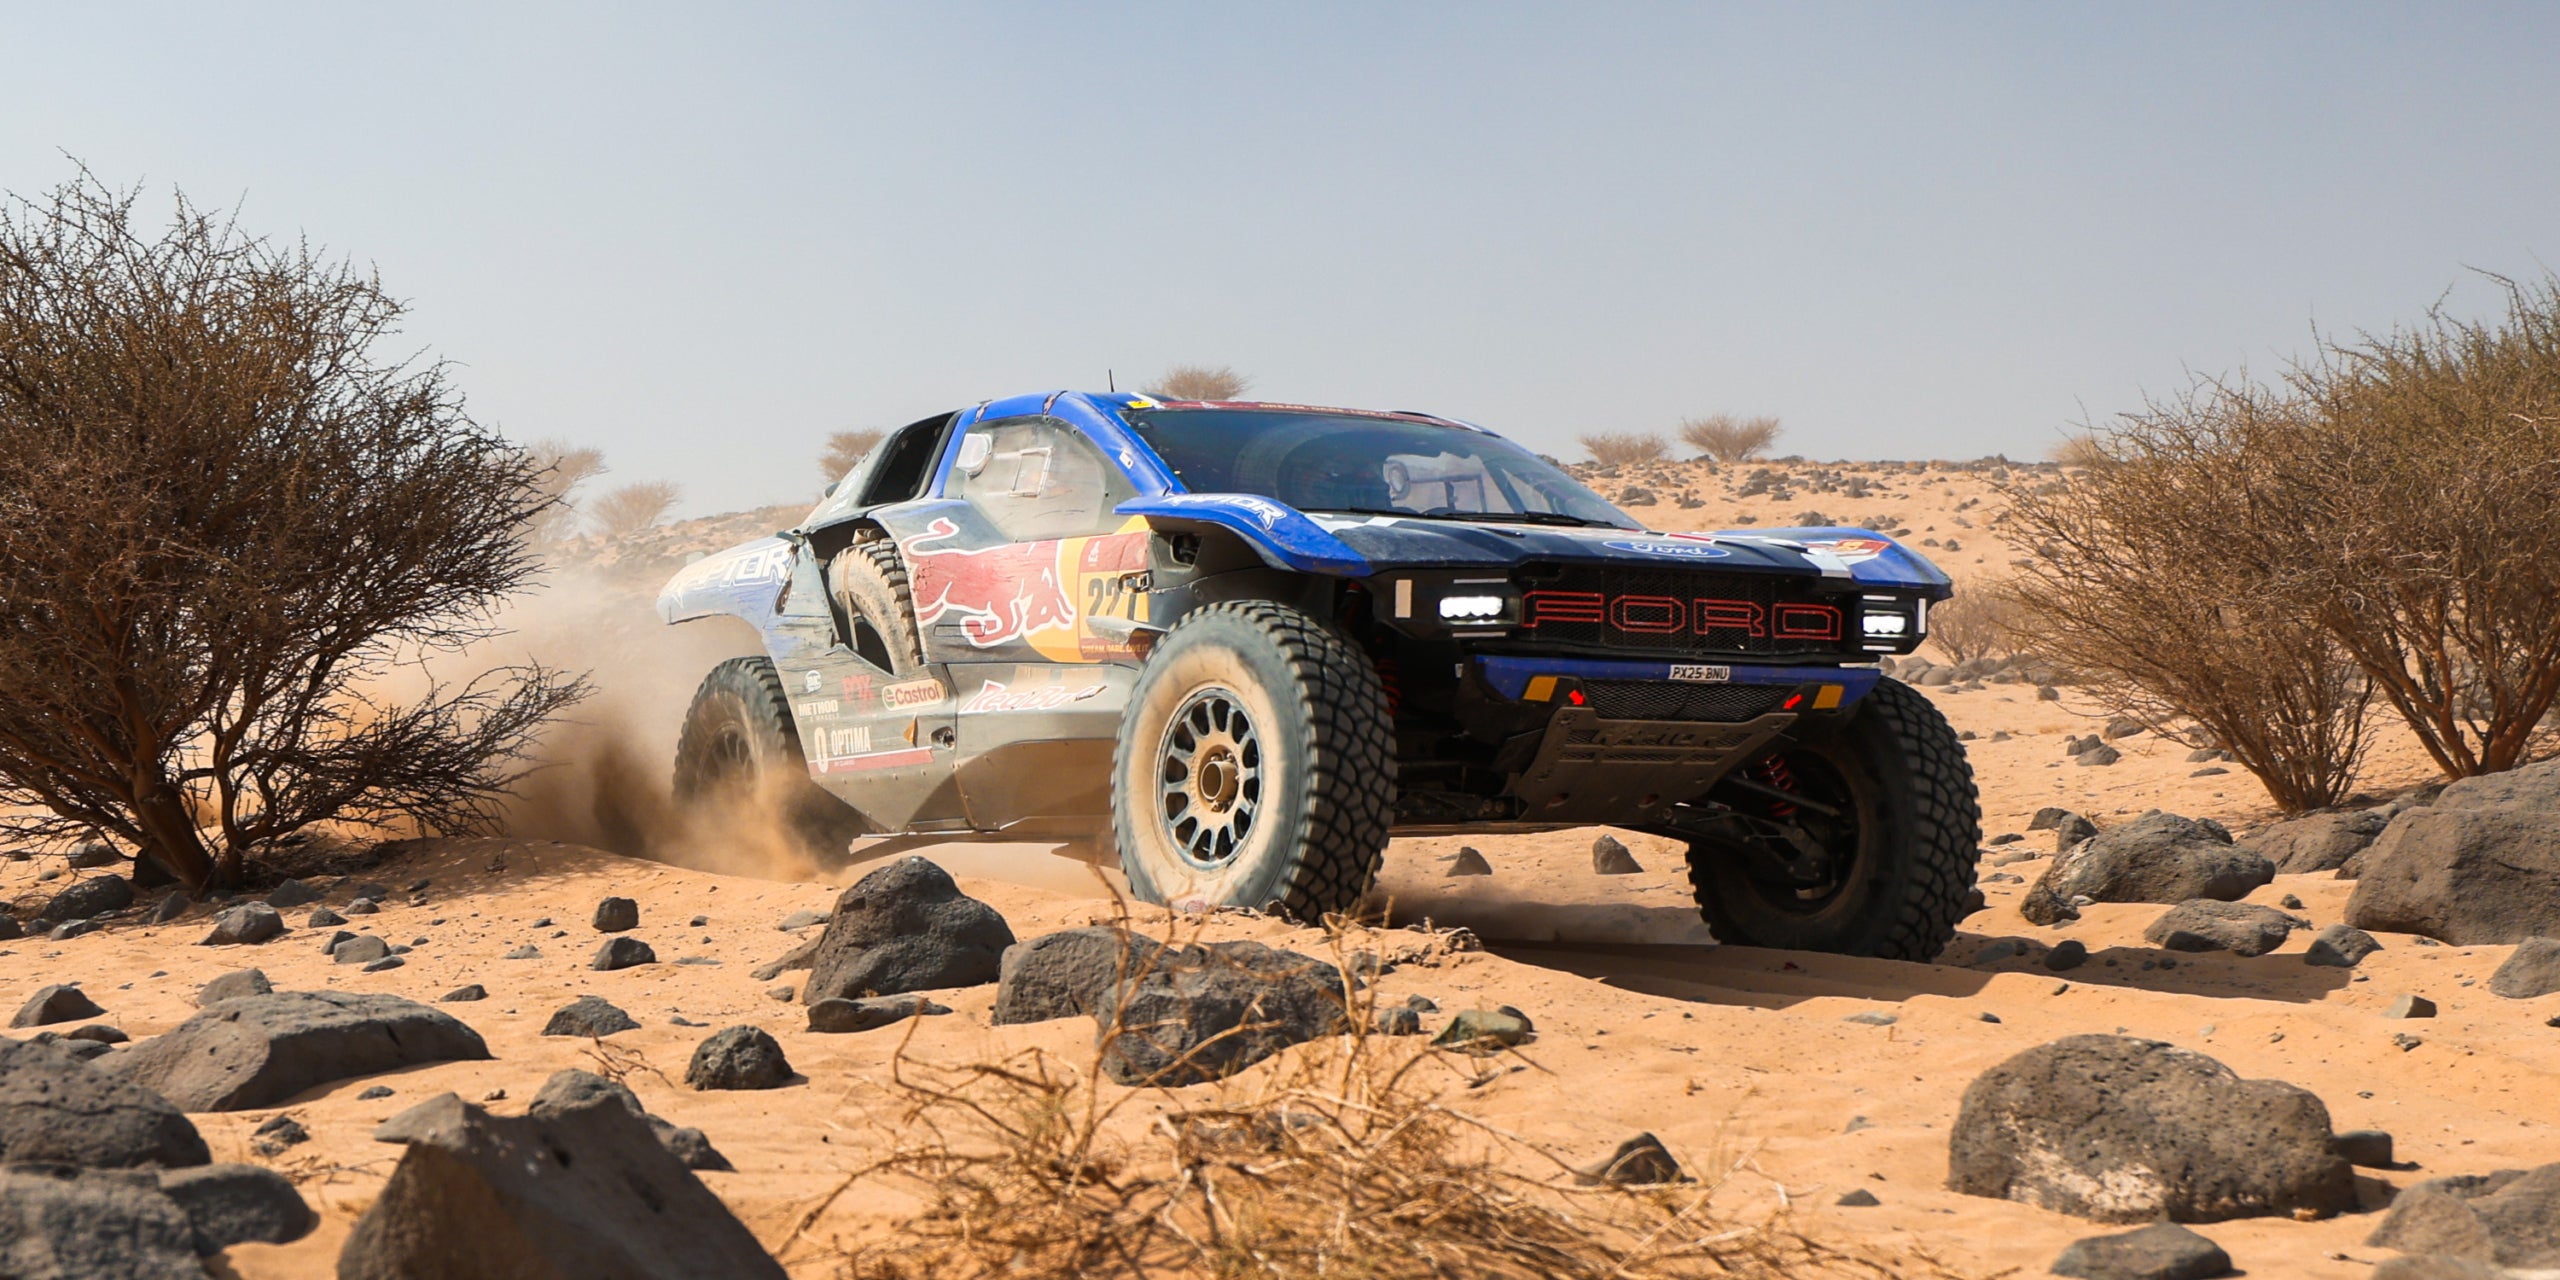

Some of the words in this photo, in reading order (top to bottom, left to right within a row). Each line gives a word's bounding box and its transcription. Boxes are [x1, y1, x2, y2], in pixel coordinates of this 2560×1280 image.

[1632, 541, 1709, 556] Ford
[1522, 588, 1842, 640] FORD
[1671, 666, 1702, 679] PX25
[1705, 667, 1728, 680] BNU
[895, 683, 940, 705] Castrol
[798, 699, 838, 716] METHOD
[831, 726, 872, 756] OPTIMA
